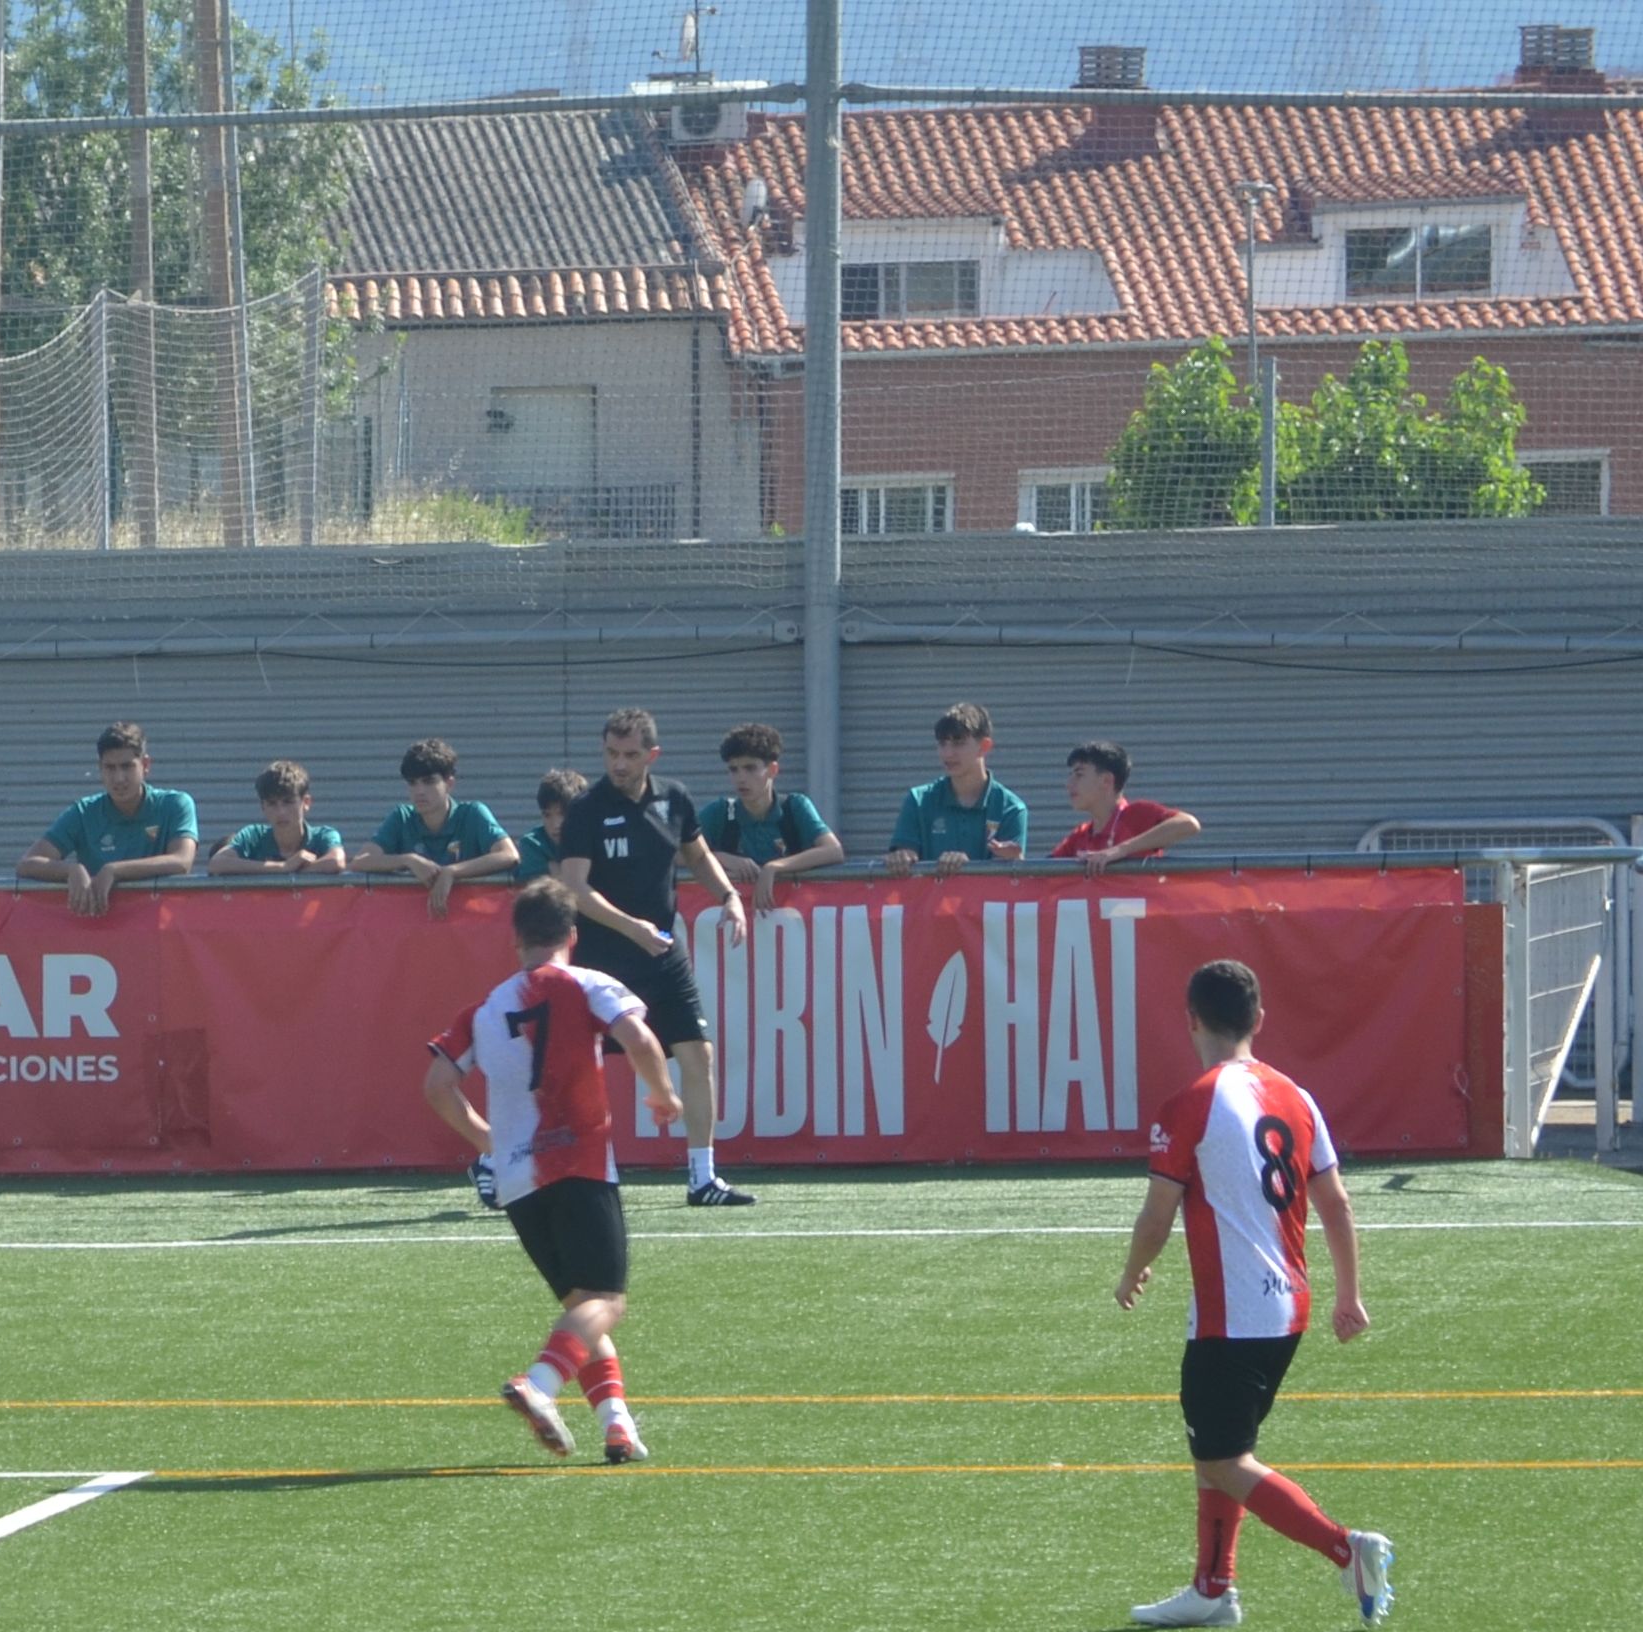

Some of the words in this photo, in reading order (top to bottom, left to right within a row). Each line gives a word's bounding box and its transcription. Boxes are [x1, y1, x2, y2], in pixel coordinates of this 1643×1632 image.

[505, 1000, 551, 1092] 7
[982, 898, 1146, 1133] HAT
[1255, 1115, 1296, 1212] 8
